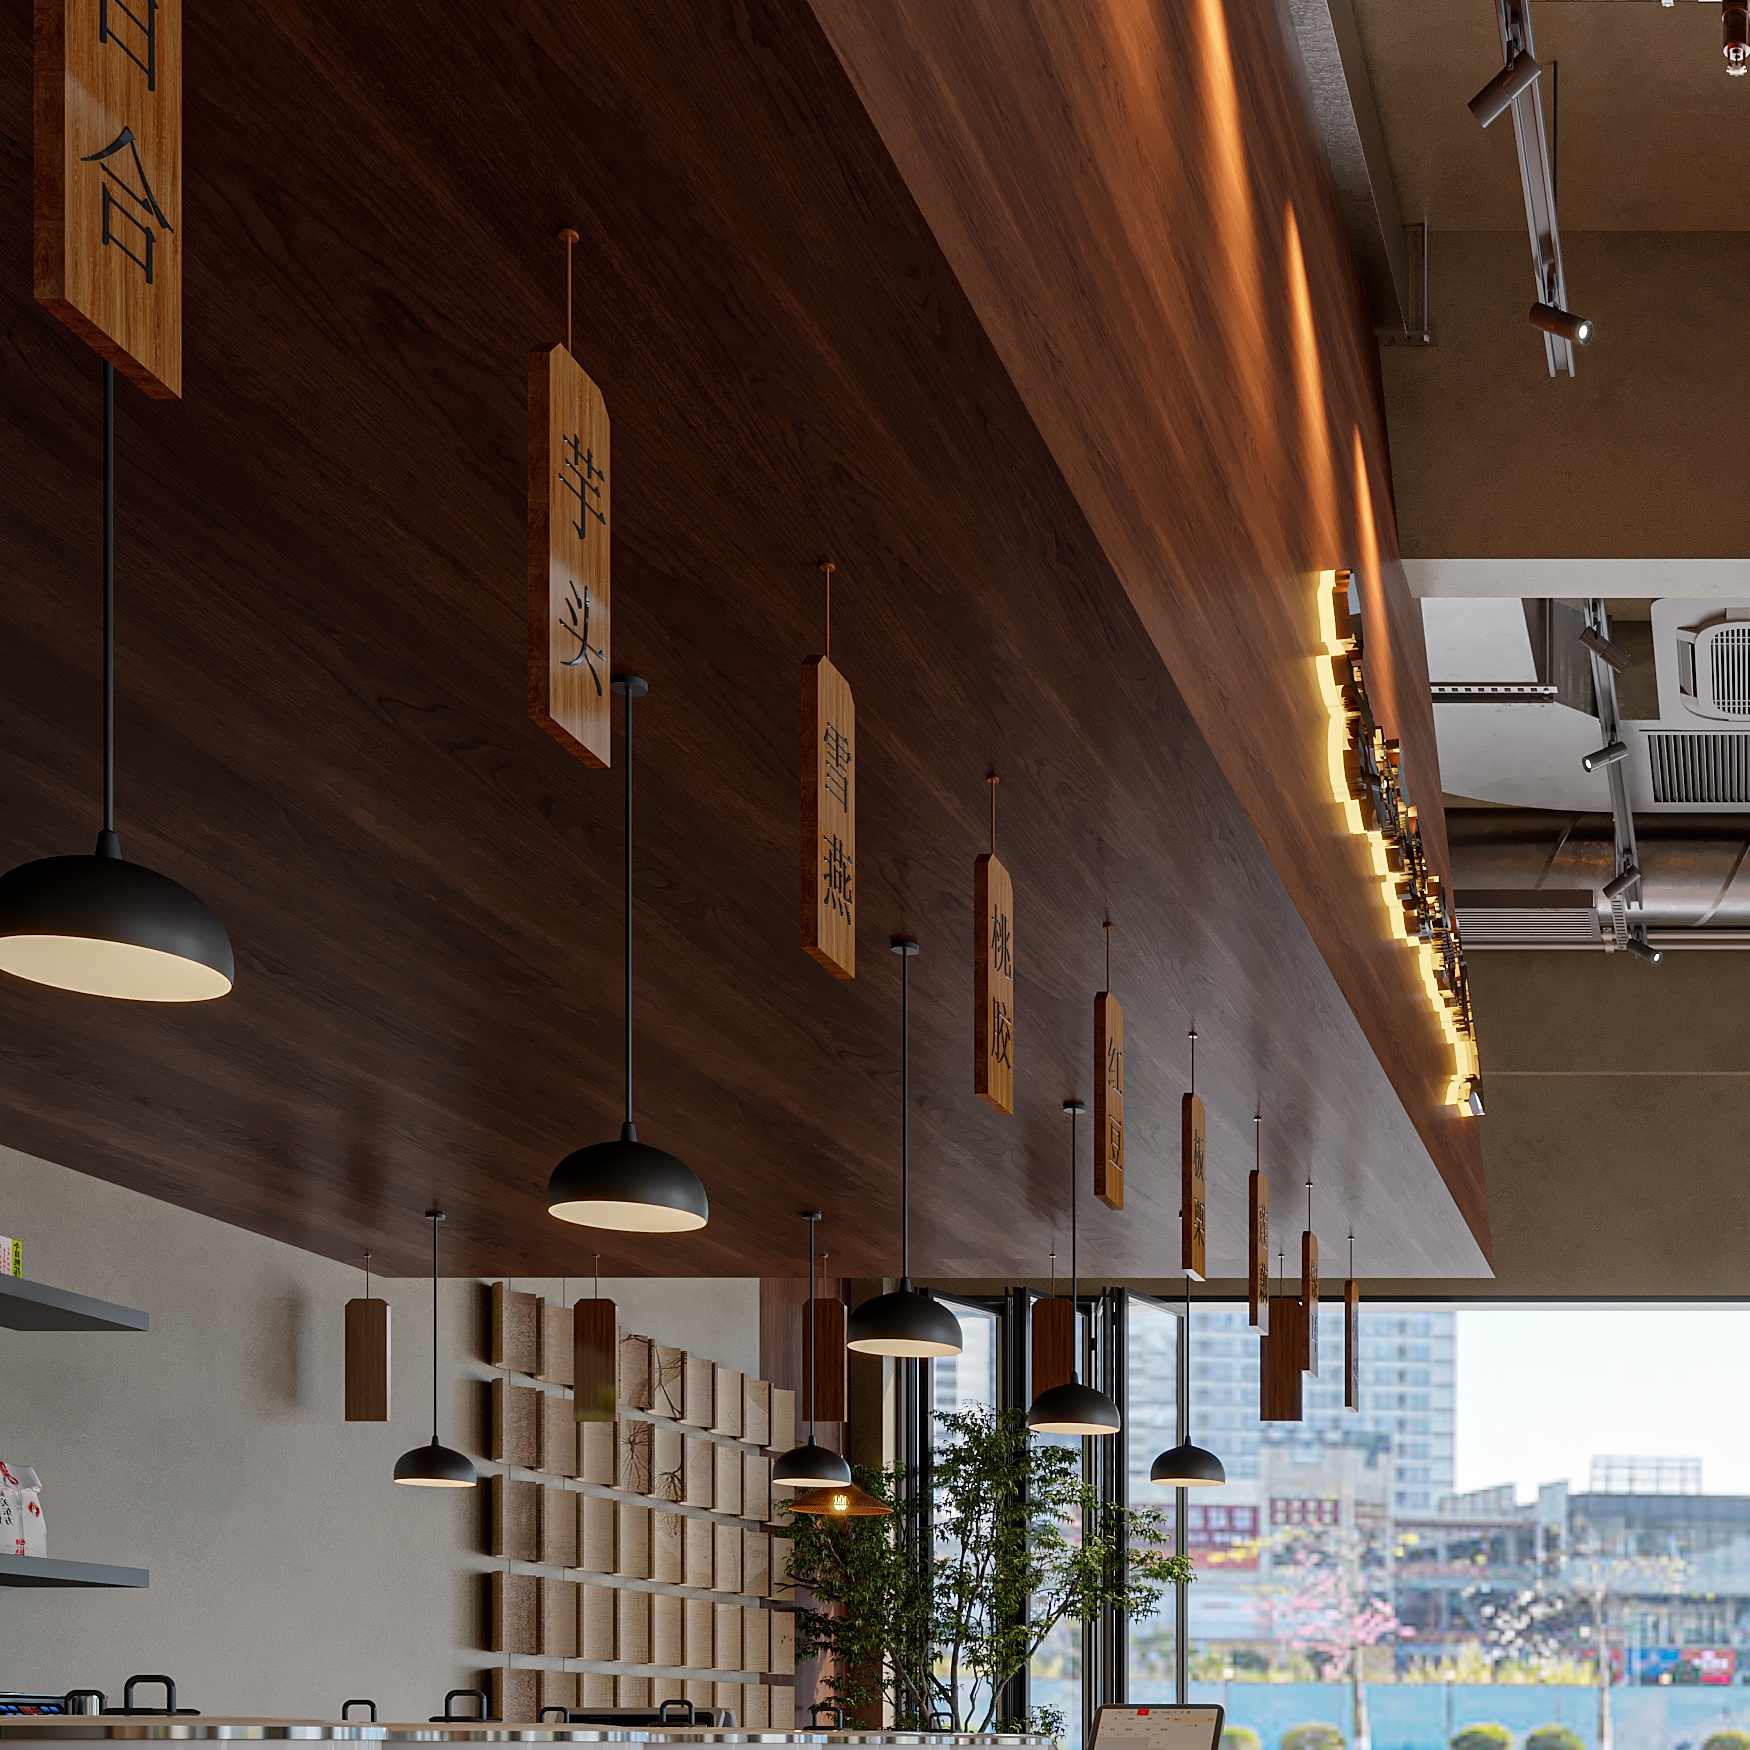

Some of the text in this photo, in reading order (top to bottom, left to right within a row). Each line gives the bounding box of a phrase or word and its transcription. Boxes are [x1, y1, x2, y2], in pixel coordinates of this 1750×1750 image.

[558, 433, 606, 697] 芋头
[824, 721, 852, 925] 雪燕
[991, 903, 1012, 1070] 桃胶
[1107, 1036, 1123, 1172] 红豆
[1193, 1128, 1205, 1247] 板栗
